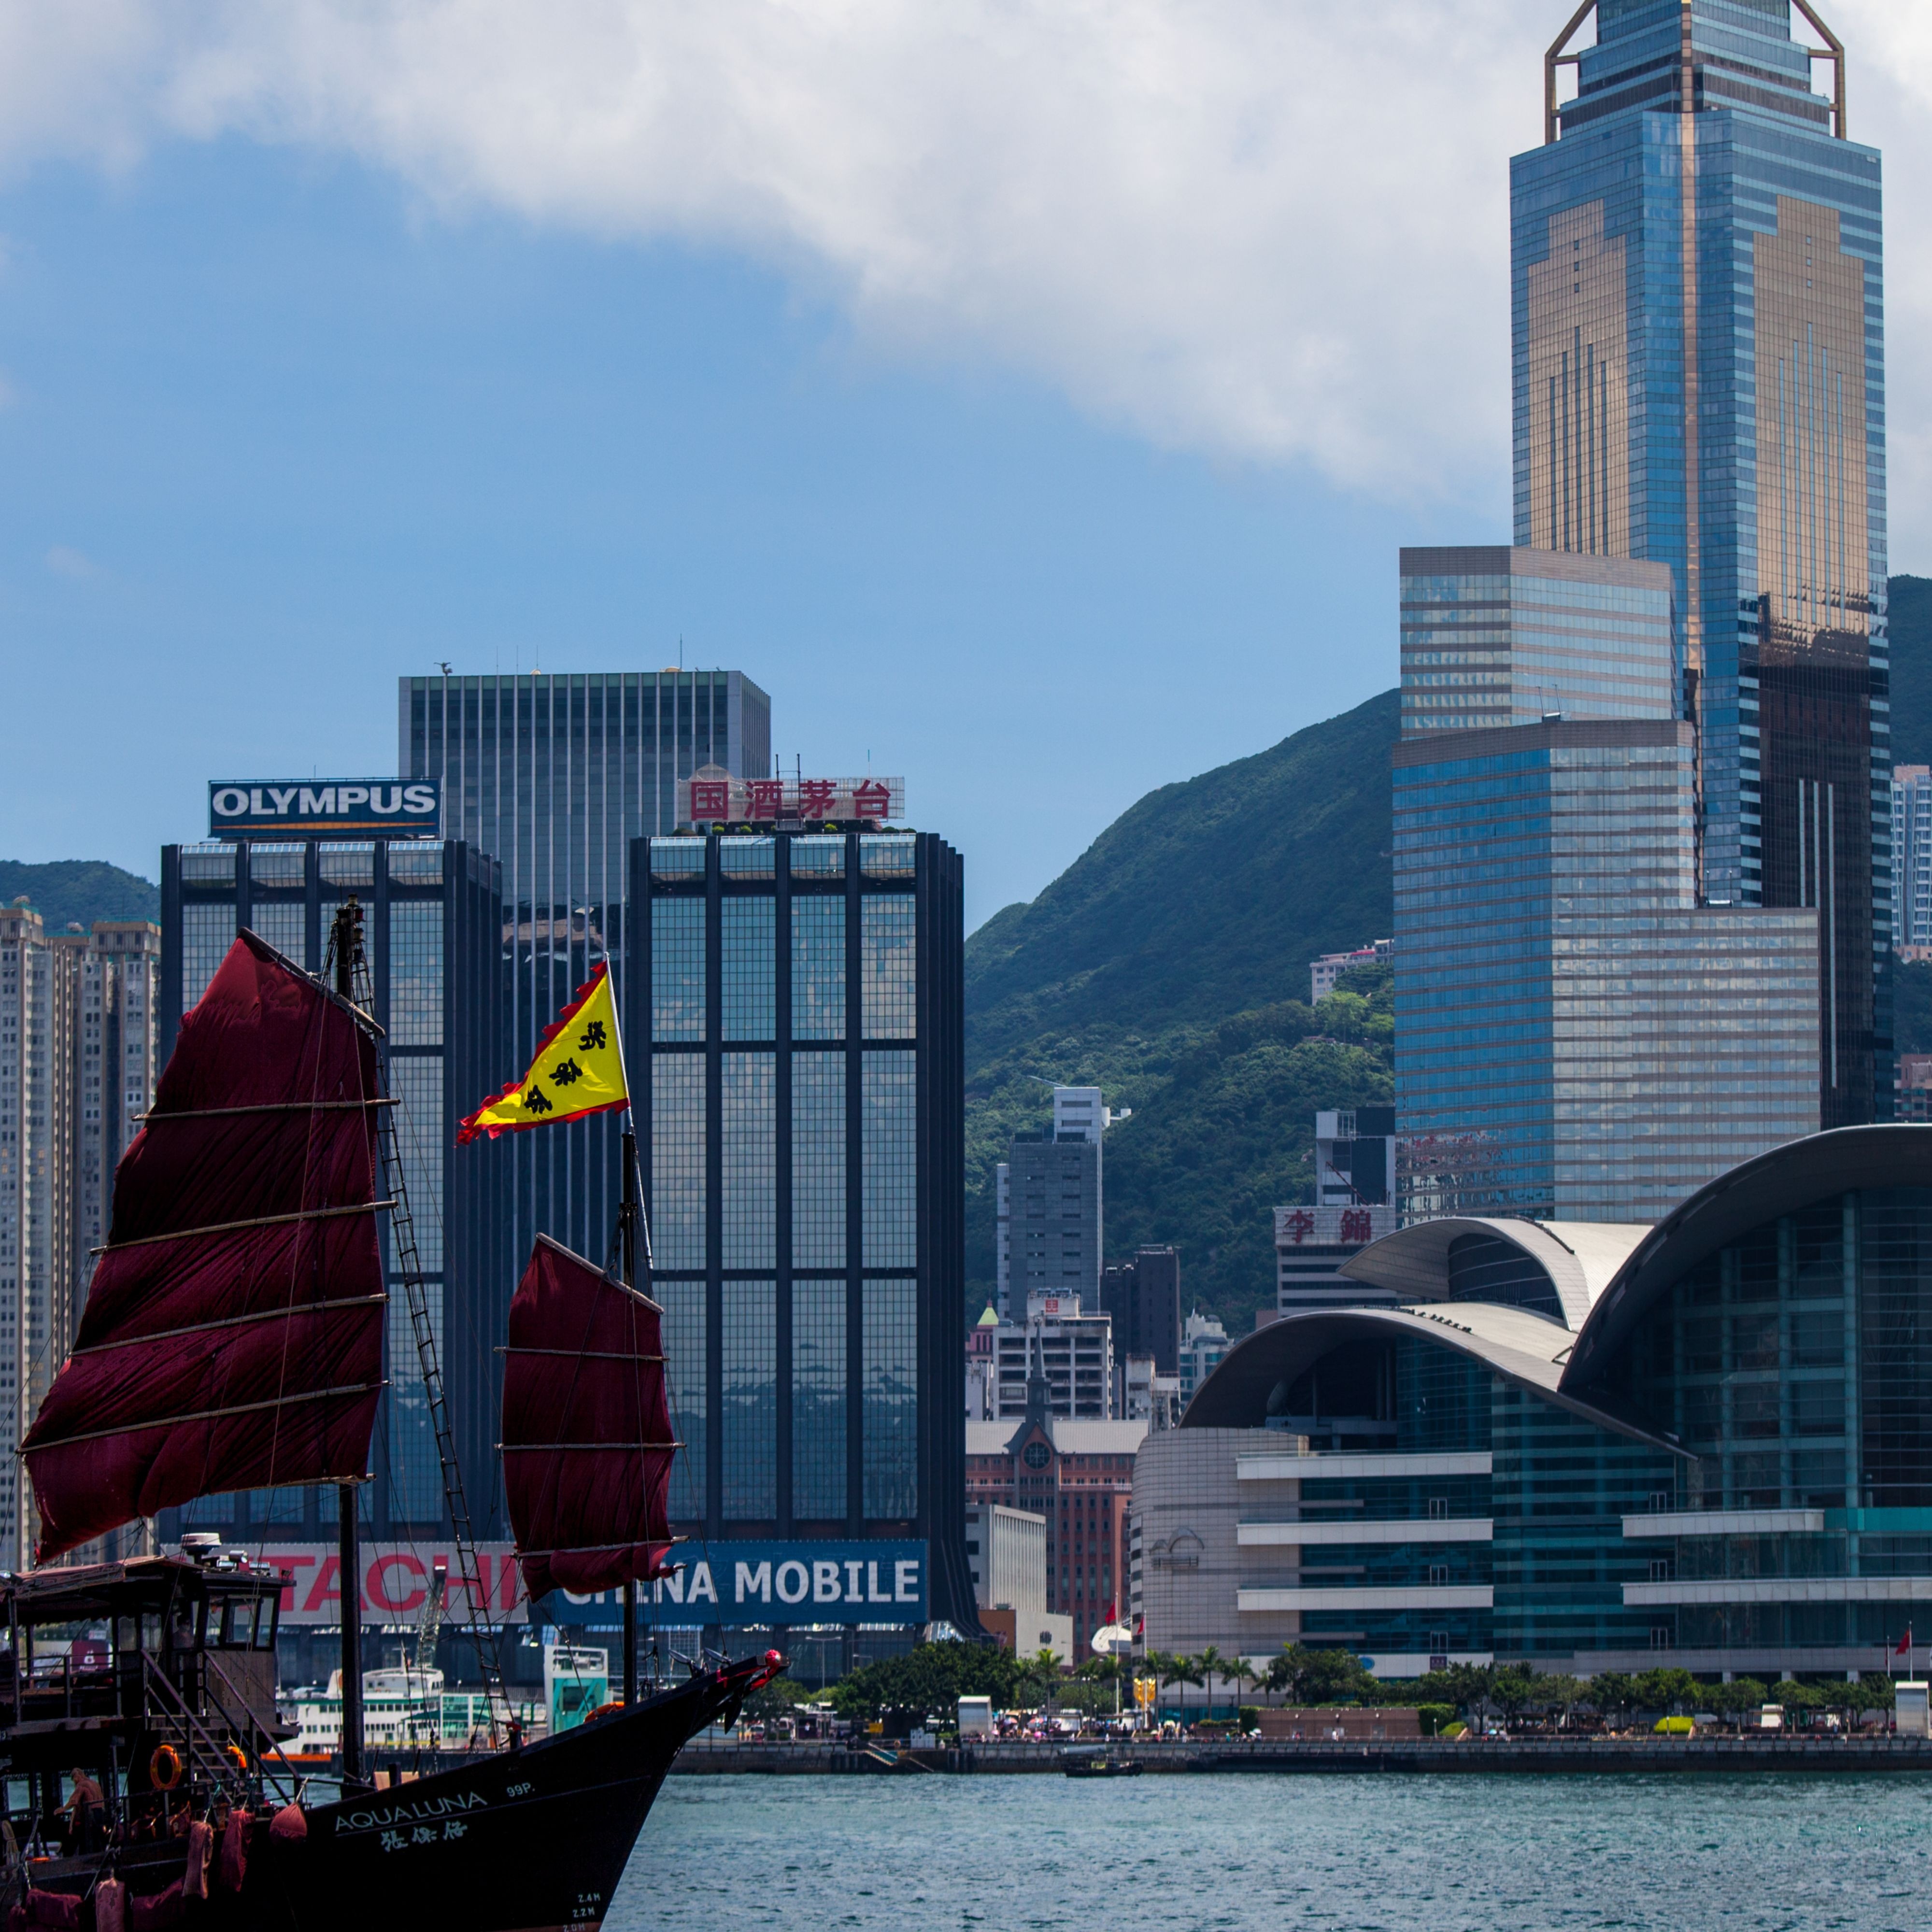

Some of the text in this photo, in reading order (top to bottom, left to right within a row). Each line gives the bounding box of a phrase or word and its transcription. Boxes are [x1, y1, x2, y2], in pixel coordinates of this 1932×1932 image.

[213, 785, 436, 817] OLYMPUS
[691, 779, 892, 821] 国酒茅台
[735, 1560, 919, 1604] MOBILE
[506, 1782, 536, 1798] 99P.
